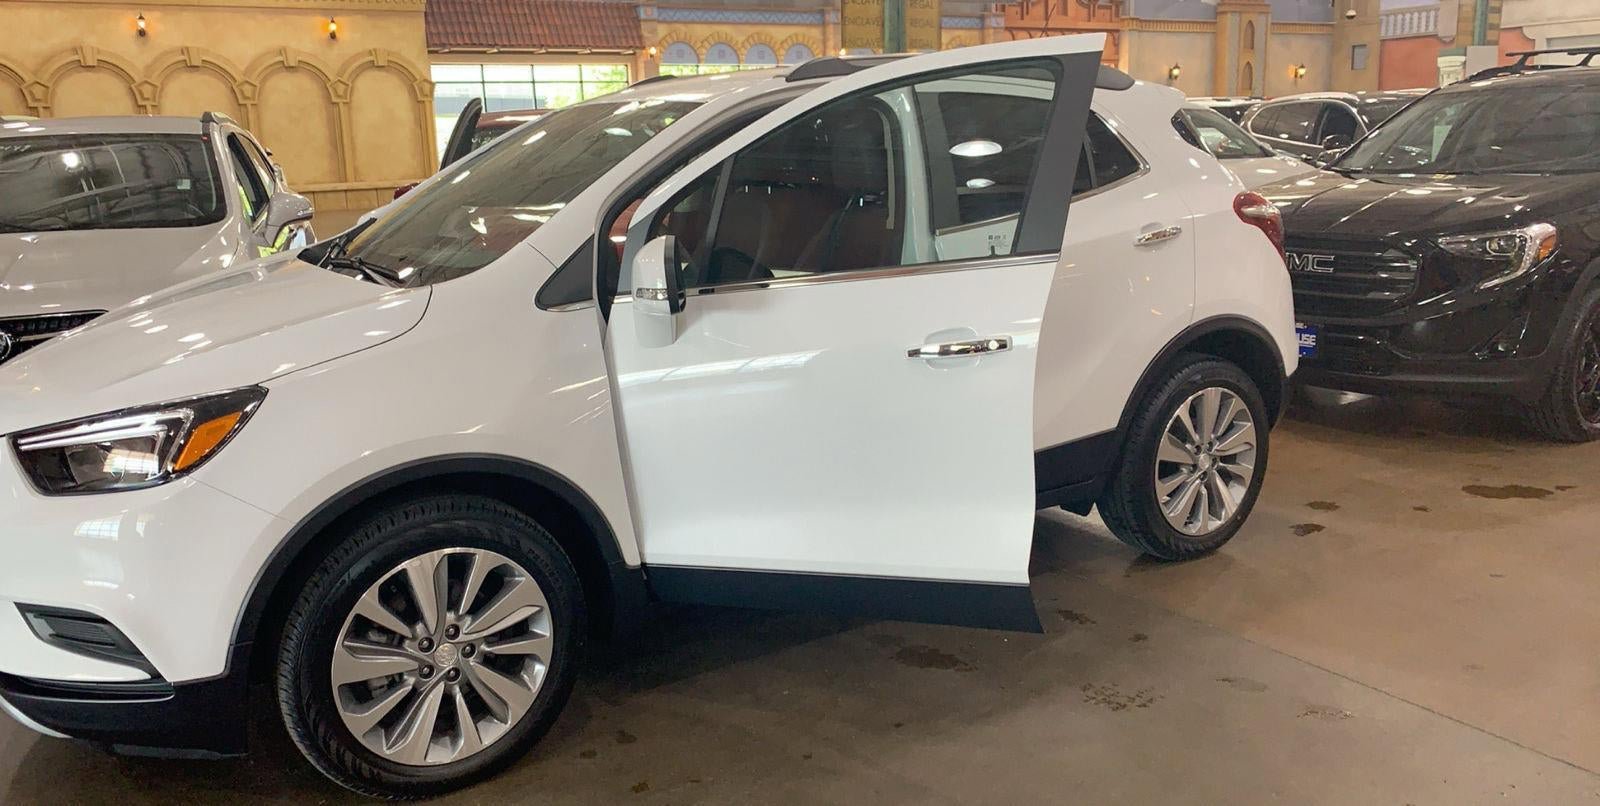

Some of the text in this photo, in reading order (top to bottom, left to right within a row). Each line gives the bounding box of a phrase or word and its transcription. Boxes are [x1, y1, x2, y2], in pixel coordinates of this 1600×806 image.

[844, 16, 881, 26] ENCLAVE
[909, 18, 934, 28] REGAL
[1286, 252, 1335, 272] MC
